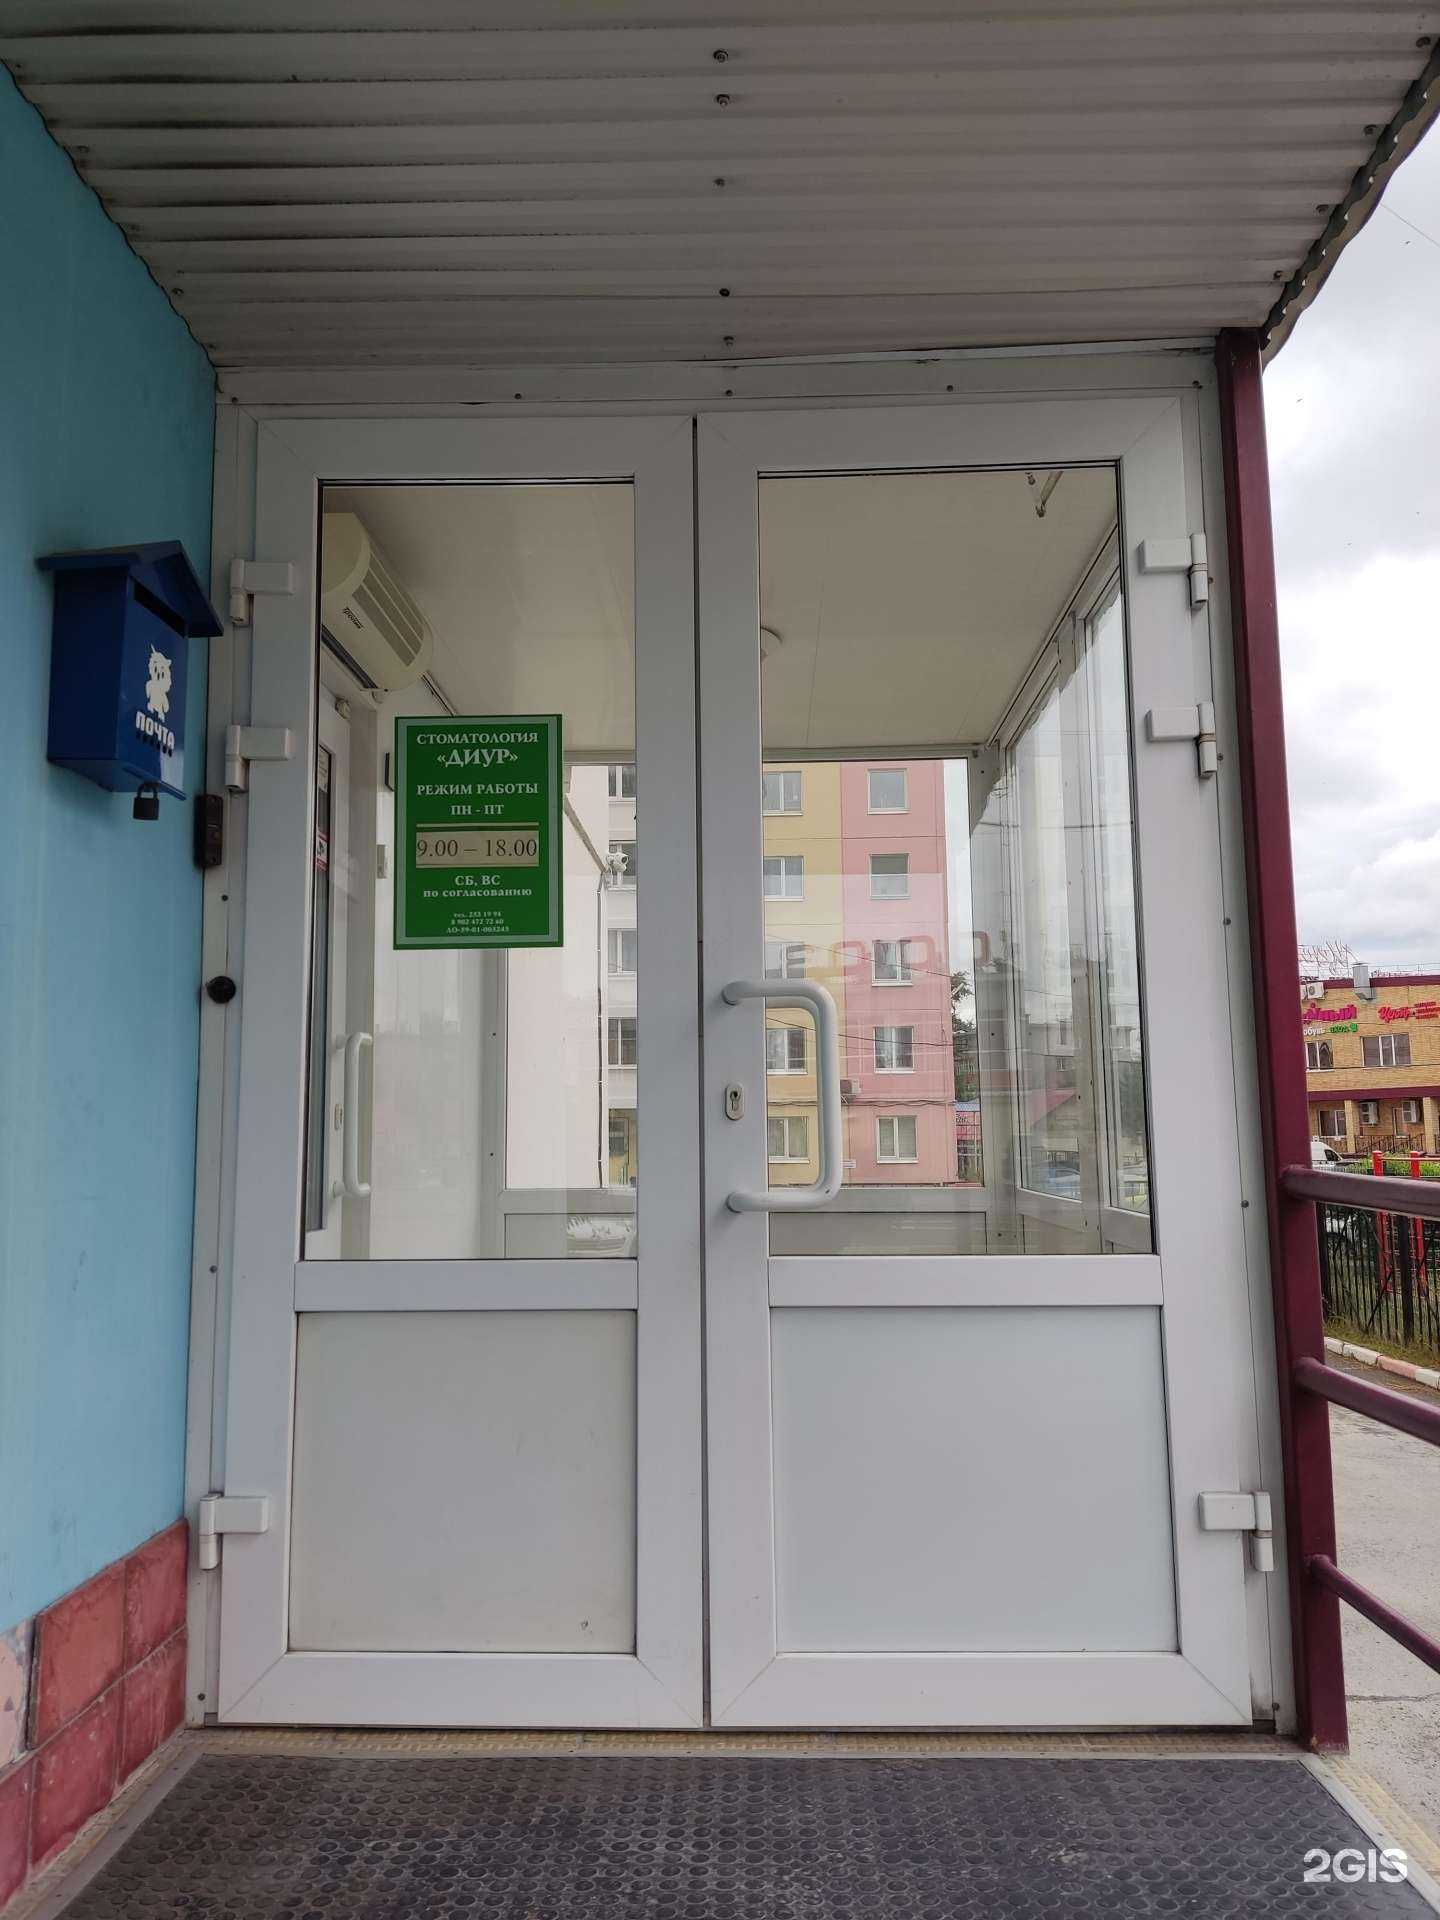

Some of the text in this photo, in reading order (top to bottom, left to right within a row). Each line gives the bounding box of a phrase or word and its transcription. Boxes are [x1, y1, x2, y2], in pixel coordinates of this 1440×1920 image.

[135, 711, 175, 750] ПОЧТА
[416, 731, 539, 745] СТОМАТОЛОГИЯ
[437, 749, 518, 767] «ДИУР»
[416, 783, 539, 796] РЕЖИМ РАБОТЫ
[450, 804, 472, 816] ПН
[484, 804, 504, 815] ПТ
[417, 839, 459, 857] 9.00
[486, 839, 538, 857] 18.00
[482, 874, 501, 885] ВС
[423, 887, 533, 898] по согласованию
